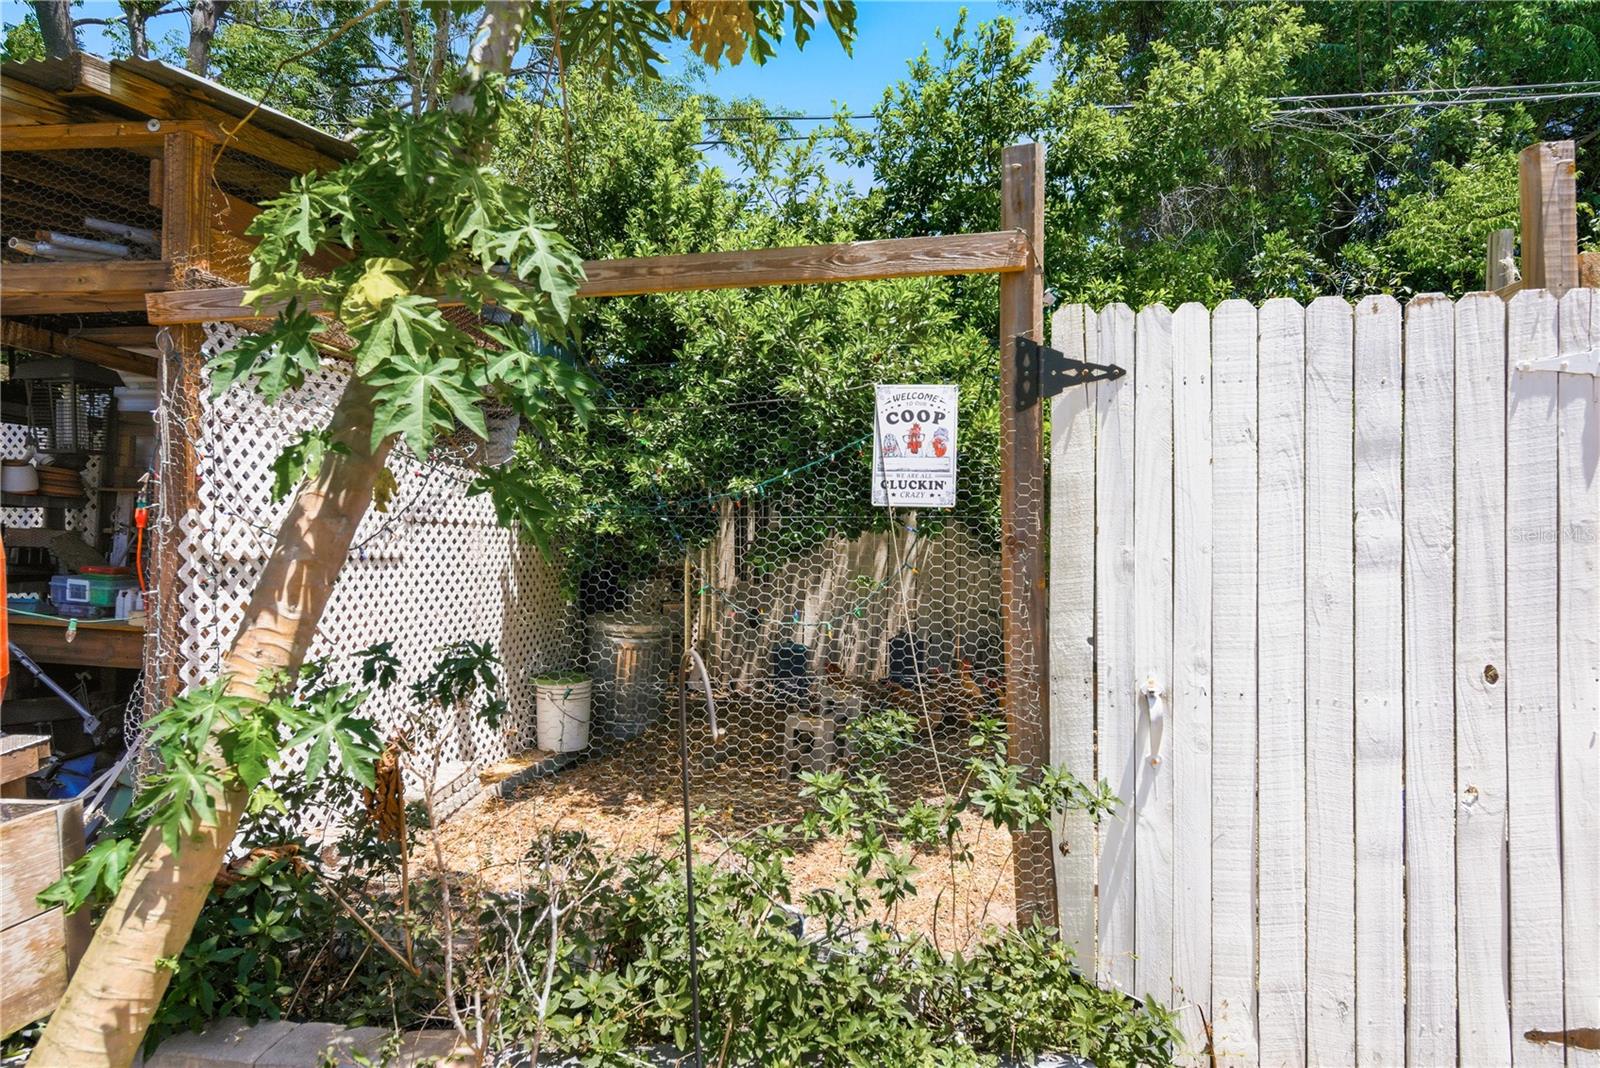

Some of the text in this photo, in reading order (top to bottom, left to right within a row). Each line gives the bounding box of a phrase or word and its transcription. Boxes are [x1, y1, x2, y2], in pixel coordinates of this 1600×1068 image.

[892, 391, 939, 403] WELCOME
[885, 409, 946, 425] COOP
[880, 479, 947, 490] CLUCKIN'
